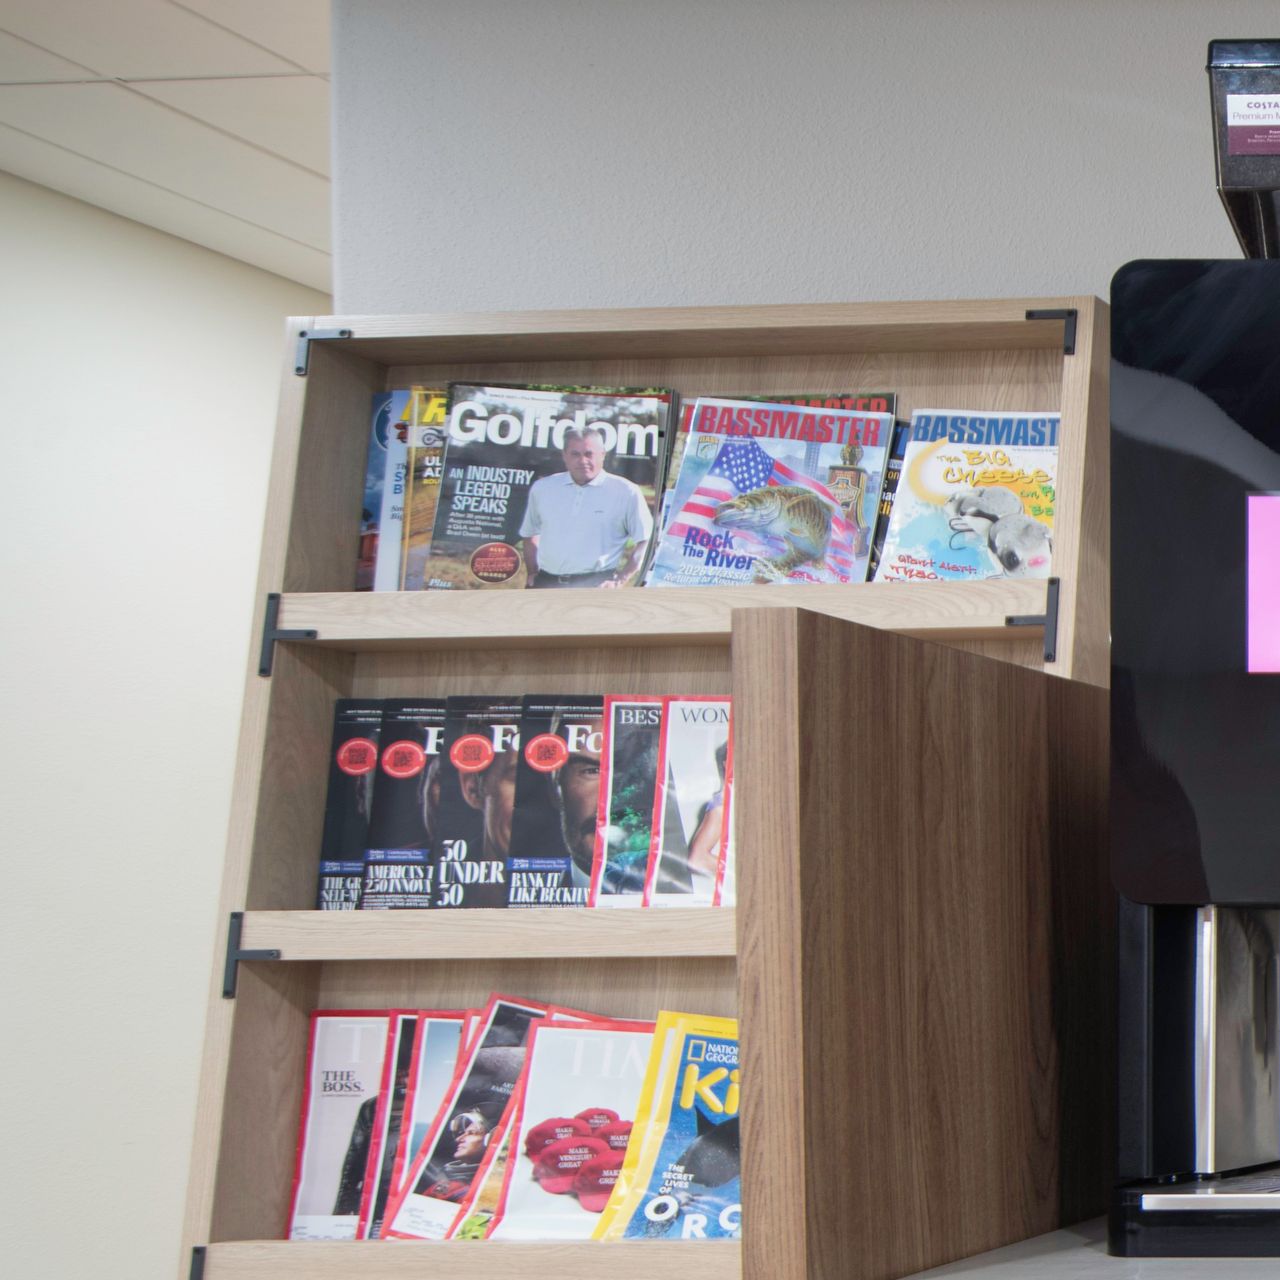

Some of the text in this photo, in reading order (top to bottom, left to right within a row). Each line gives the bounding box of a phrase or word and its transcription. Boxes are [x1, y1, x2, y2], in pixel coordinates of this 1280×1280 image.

[1247, 101, 1280, 109] COSTA
[1232, 112, 1274, 120] Premium
[449, 401, 658, 456] Golfdom
[697, 404, 881, 447] BASSMASTER
[449, 465, 535, 485] AN INDUSTRY
[456, 481, 511, 499] LEGEND
[452, 495, 508, 514] SPEAKS
[684, 526, 734, 549] Rock
[683, 545, 757, 570] The River
[620, 708, 661, 725] BES
[439, 839, 467, 861] 30
[439, 861, 504, 884] UNDER
[437, 884, 464, 906] 30
[509, 887, 537, 903] LIKE
[322, 1070, 355, 1081] THE
[321, 1081, 365, 1093] BOSS.
[662, 1172, 694, 1182] SECRET
[668, 1163, 685, 1173] THE
[664, 1180, 689, 1189] LIVES
